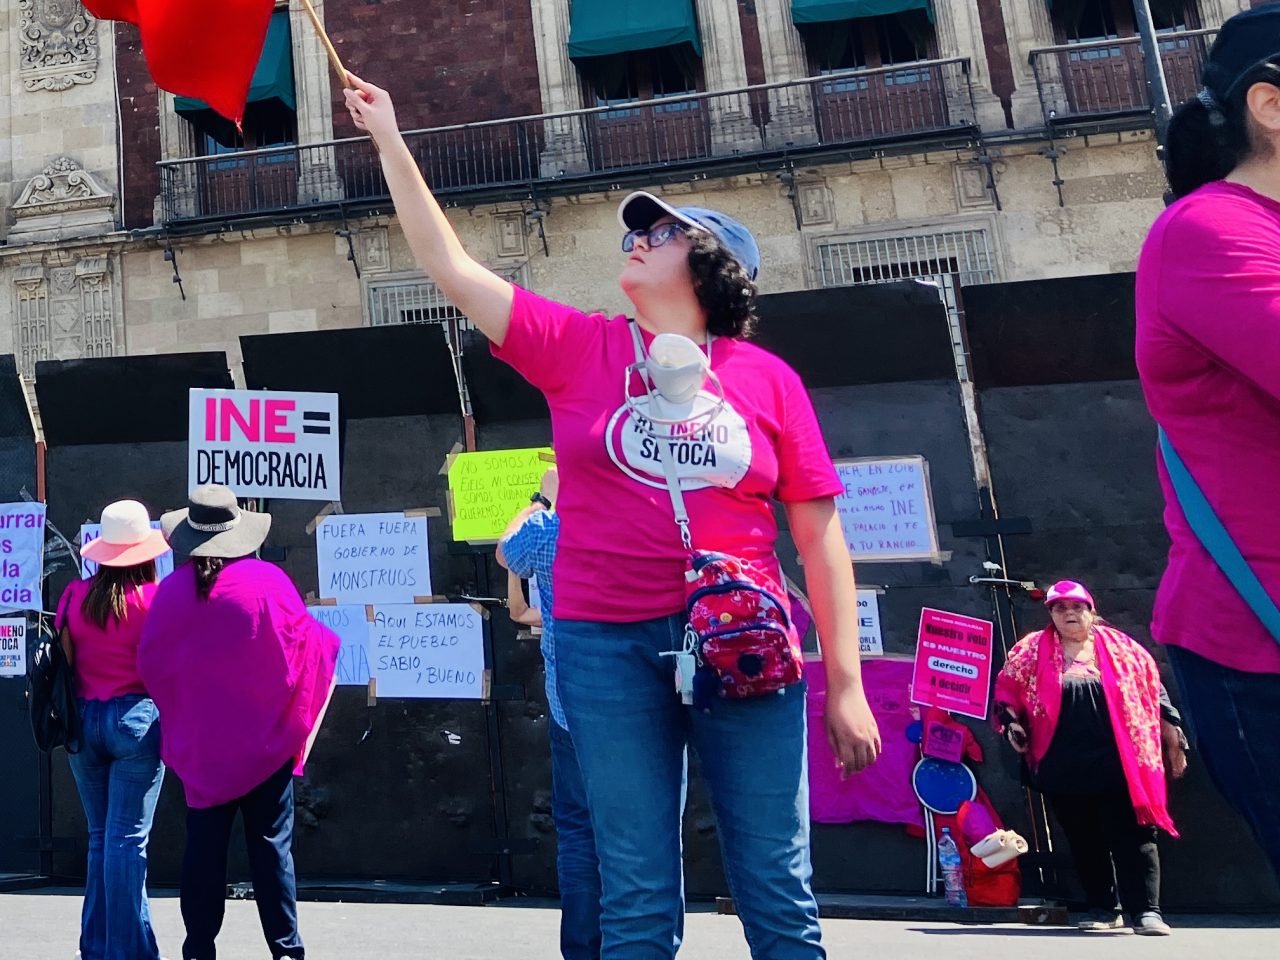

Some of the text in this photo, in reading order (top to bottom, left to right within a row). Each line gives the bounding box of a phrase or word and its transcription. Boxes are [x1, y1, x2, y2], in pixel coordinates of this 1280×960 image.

[197, 450, 328, 490] DEMOCRACIA
[484, 457, 524, 470] SOMOS
[888, 464, 914, 474] 2018
[492, 476, 502, 487] NI
[506, 472, 542, 485] CONSER
[460, 504, 505, 520] QUEREMOS
[890, 499, 918, 516] INE
[323, 521, 417, 540] FUERA FUERA
[905, 521, 918, 530] TE
[334, 545, 419, 560] GOBIERNO DE
[859, 541, 873, 550] TU
[2, 559, 20, 579] la
[330, 568, 417, 591] MONSTRUOS
[414, 612, 474, 629] ESTAMOS
[378, 635, 459, 649] EL PUEBLO
[937, 644, 987, 660] NUESTRO
[337, 644, 370, 683] RTA
[377, 655, 420, 671] SABIO
[932, 659, 974, 675] derecho
[426, 666, 476, 684] BUENO
